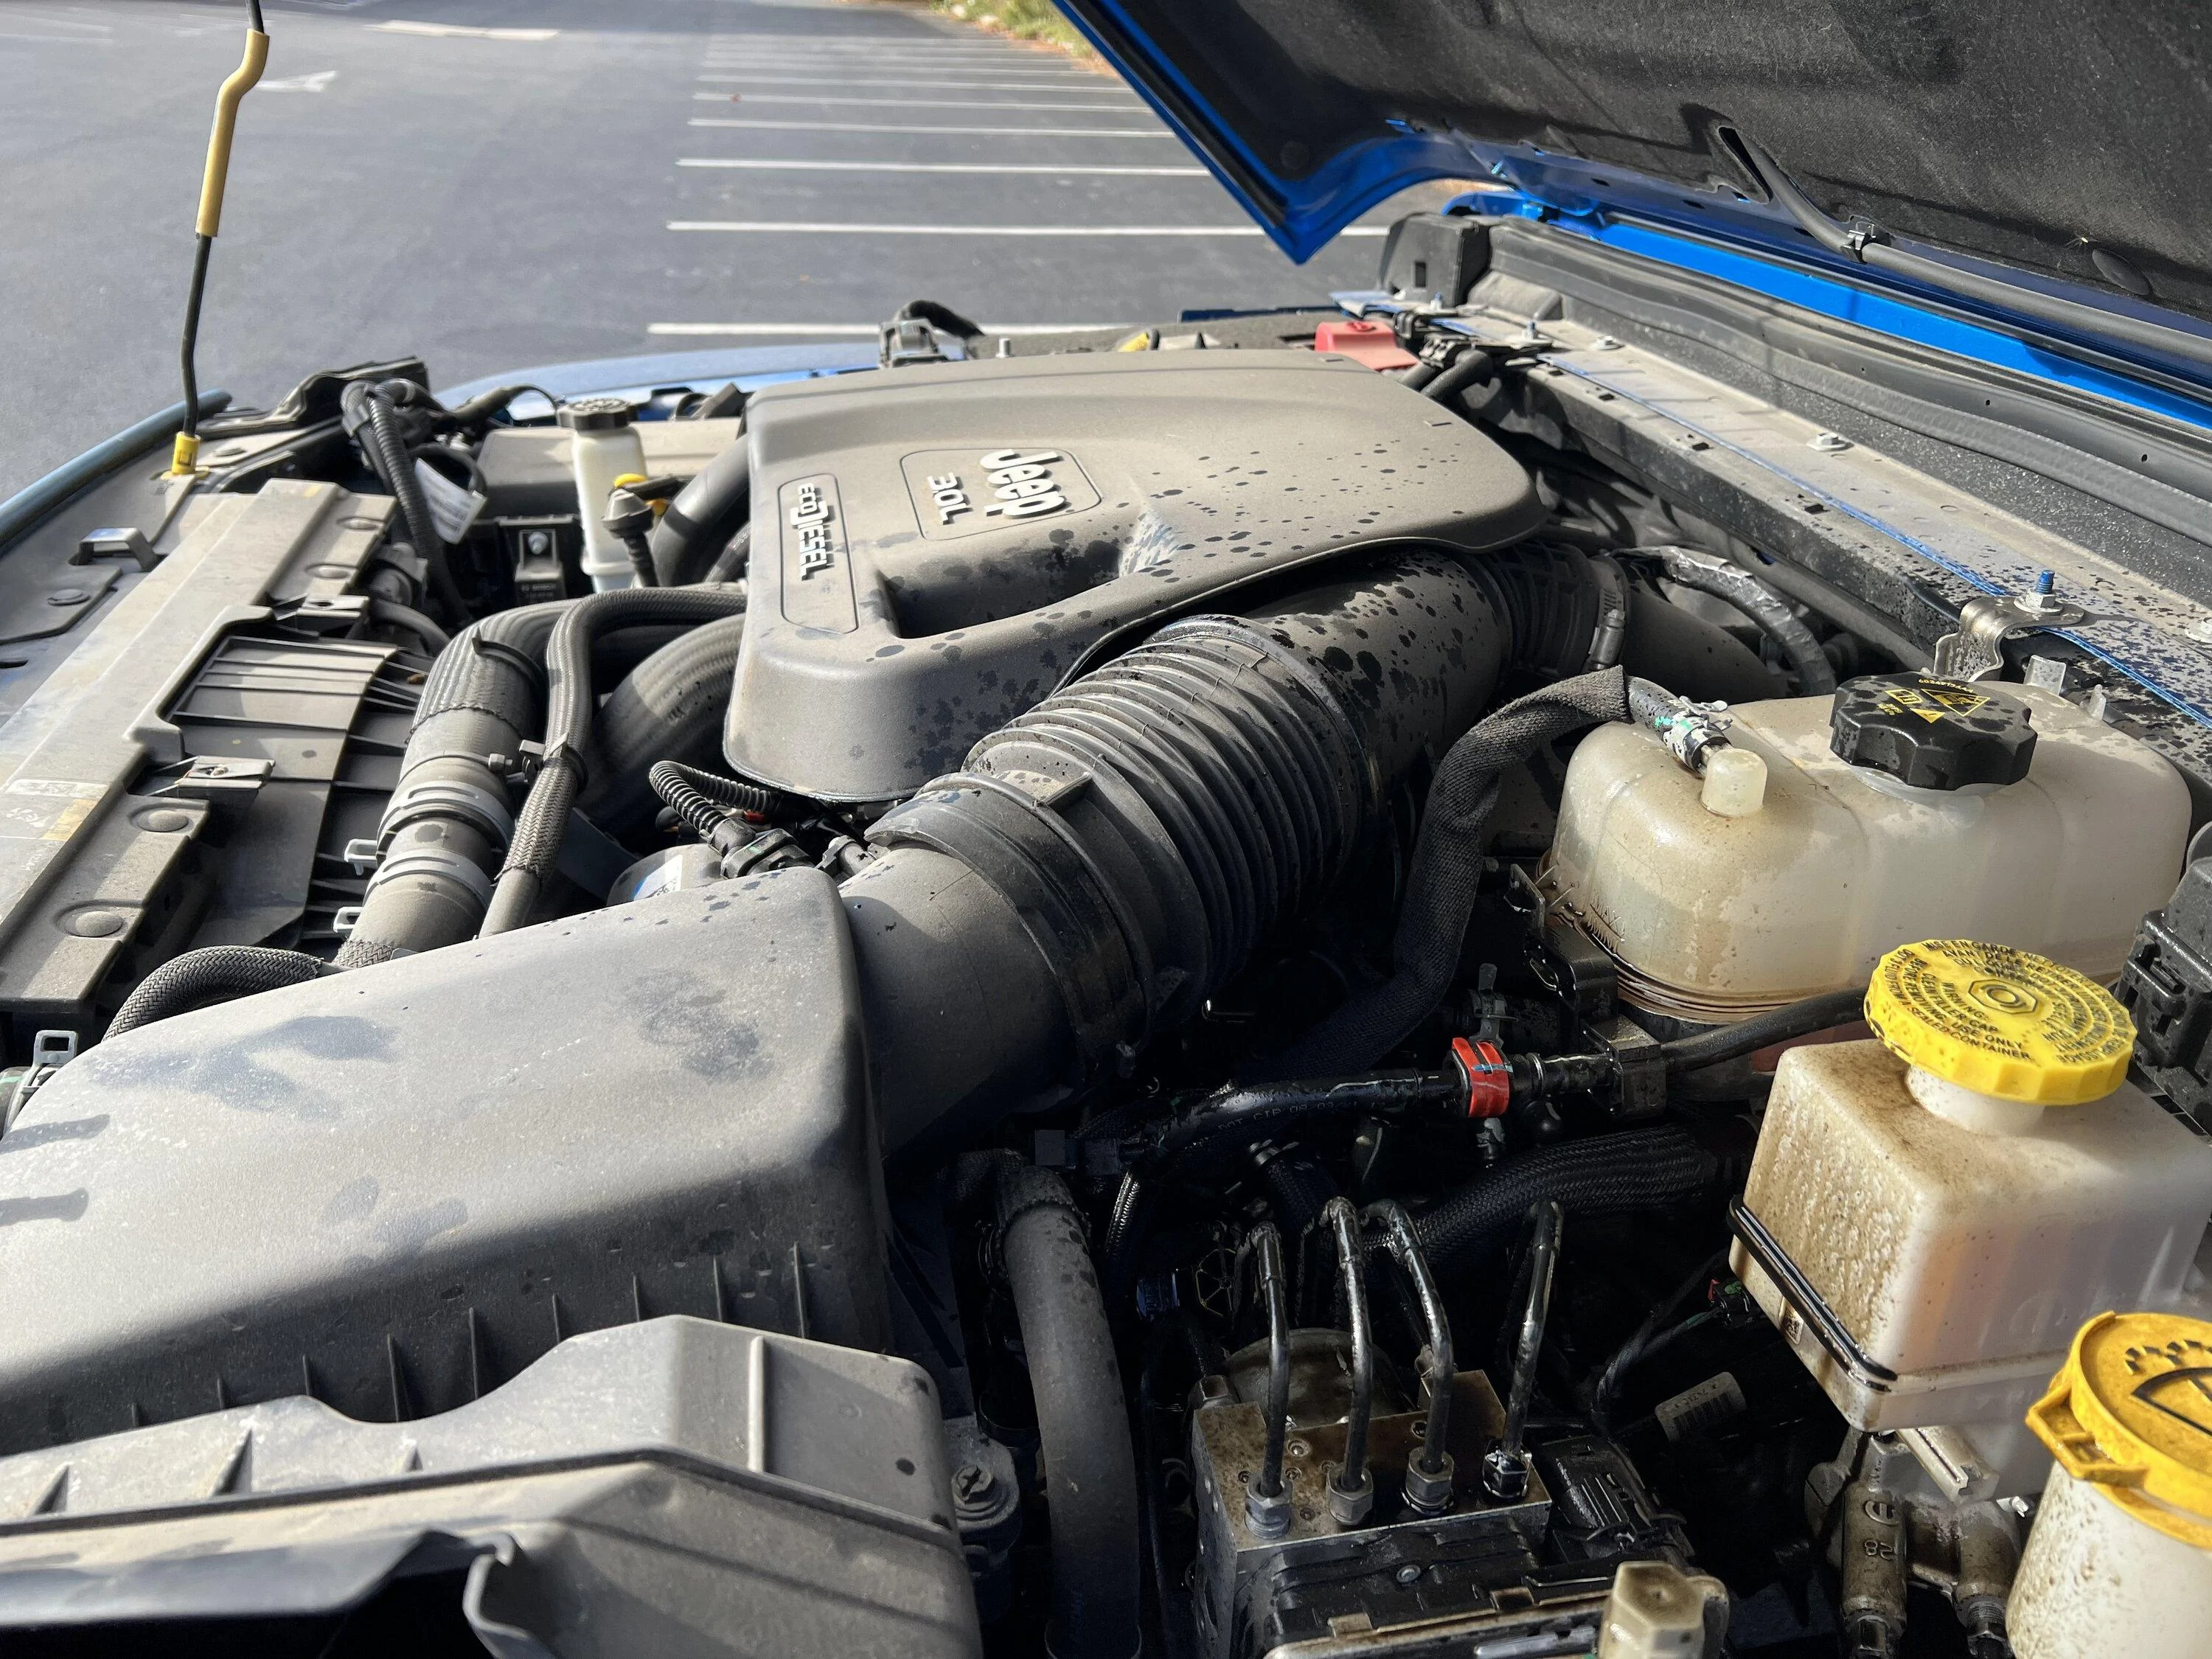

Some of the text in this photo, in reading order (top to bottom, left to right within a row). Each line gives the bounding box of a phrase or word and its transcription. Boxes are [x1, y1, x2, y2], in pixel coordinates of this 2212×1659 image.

[979, 448, 1065, 516] Jeep
[1921, 972, 1938, 994] CLEAN
[1902, 957, 1928, 982] BEFORE
[1984, 1033, 2022, 1049] ONLY
[1929, 996, 1967, 1021] FILLER
[1907, 1006, 1950, 1033] SEALED
